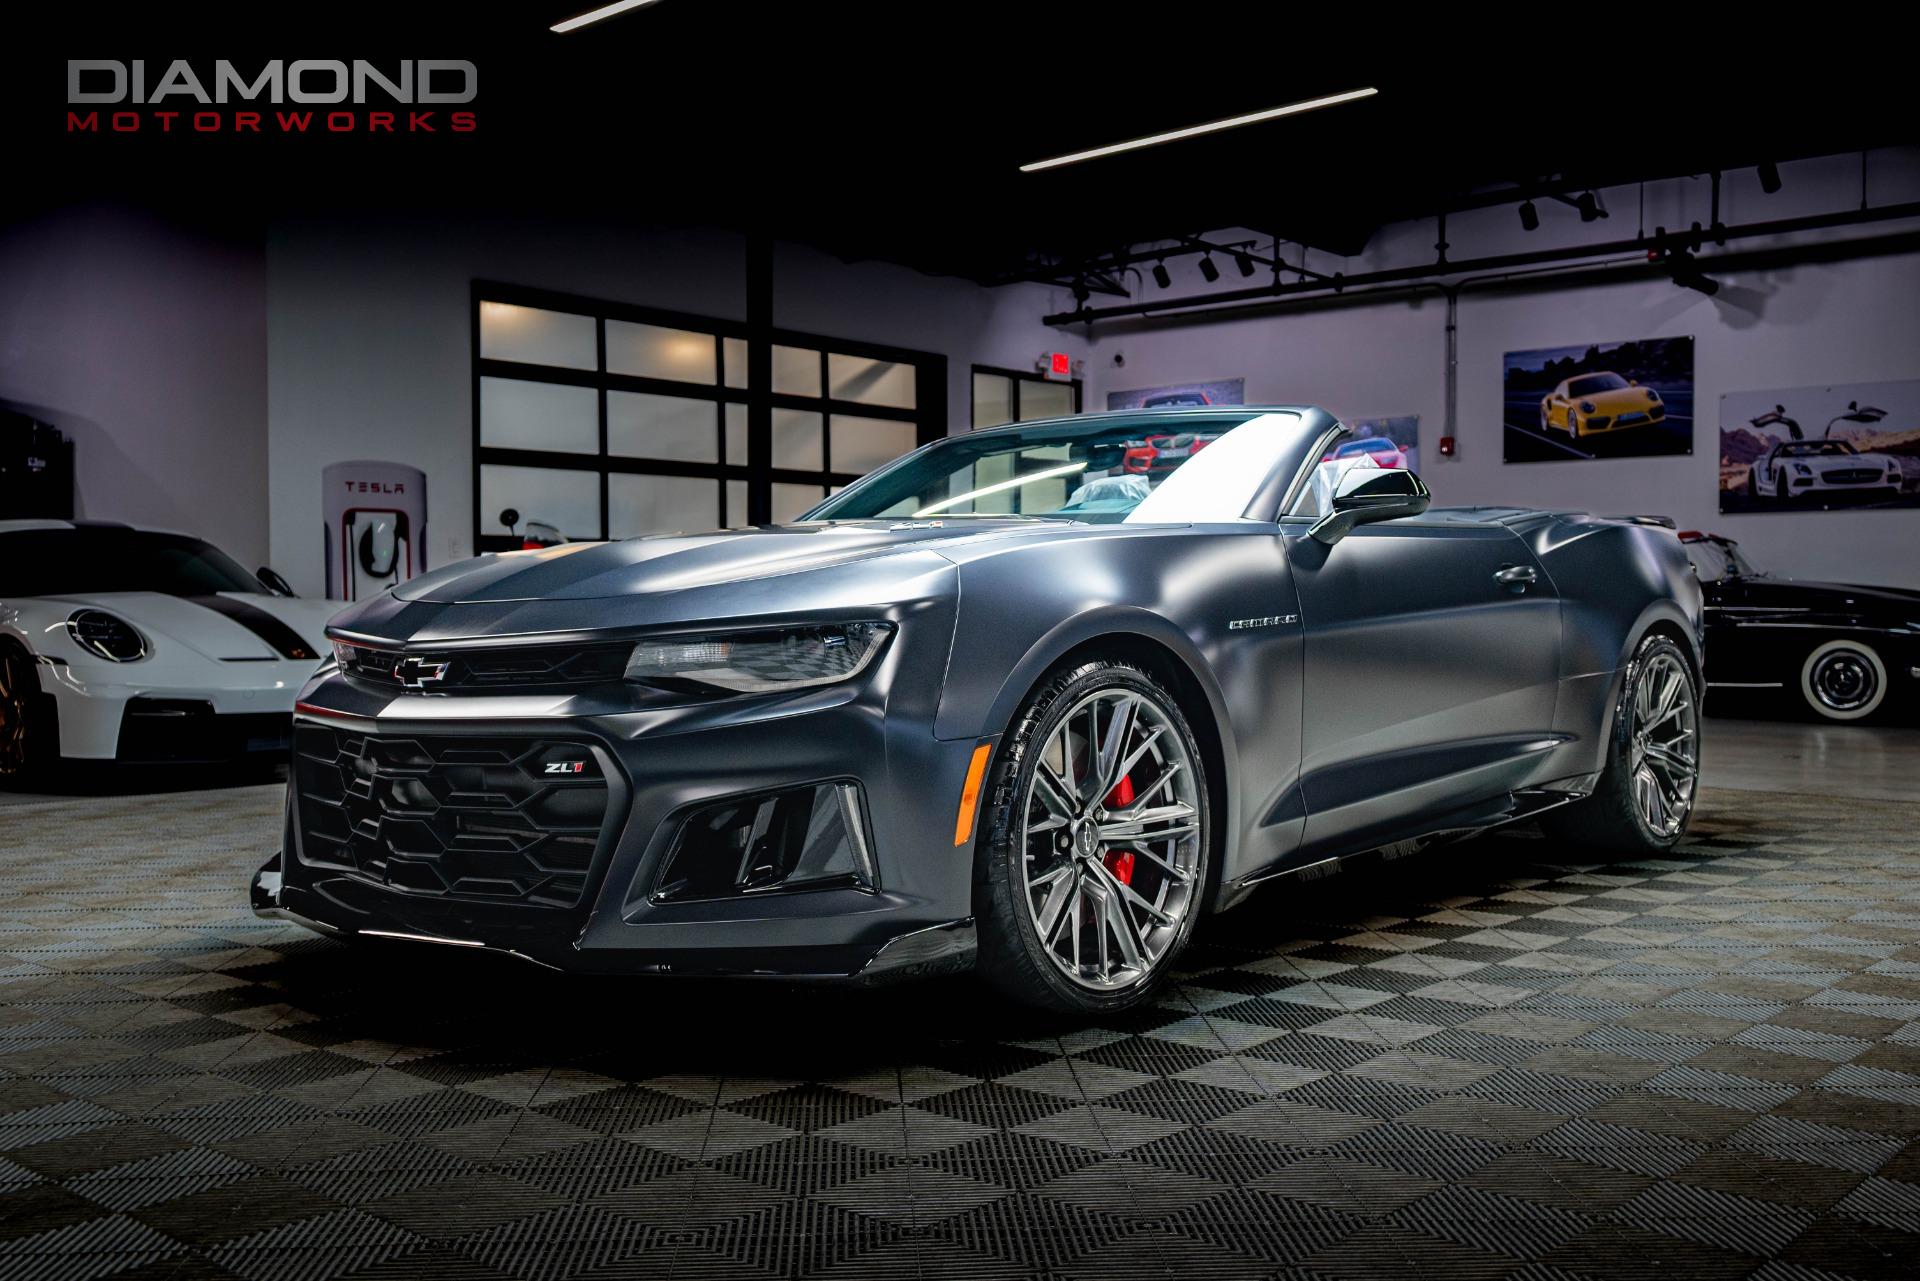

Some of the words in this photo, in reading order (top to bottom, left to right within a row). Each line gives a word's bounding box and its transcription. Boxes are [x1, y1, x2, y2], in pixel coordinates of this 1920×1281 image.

[345, 481, 404, 494] TESLA
[1229, 614, 1298, 629] CAMARO
[544, 761, 584, 773] ZL1
